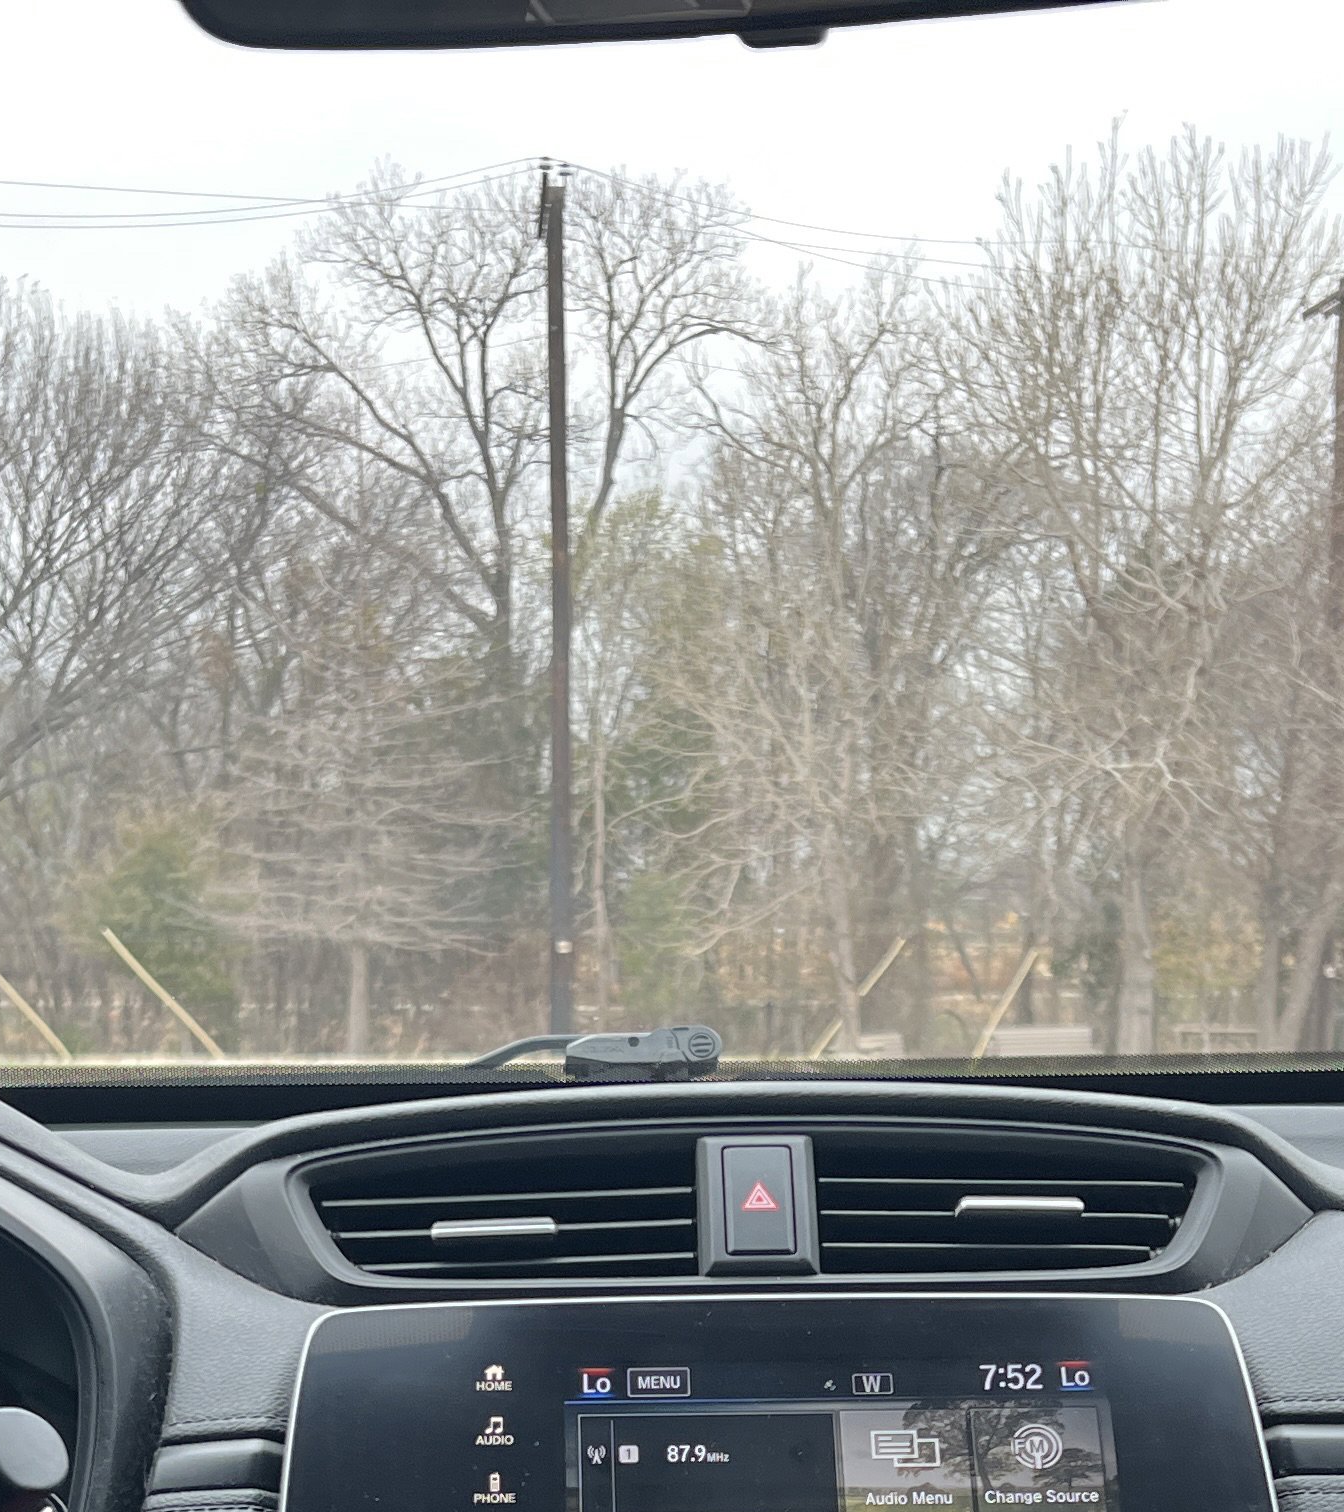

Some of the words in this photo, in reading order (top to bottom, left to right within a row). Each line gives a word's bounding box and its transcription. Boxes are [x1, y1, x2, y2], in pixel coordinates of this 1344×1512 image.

[582, 1373, 611, 1394] Lo
[637, 1375, 681, 1390] MENU
[862, 1375, 882, 1393] W
[979, 1363, 1044, 1391] 7:52
[1061, 1366, 1090, 1388] Lo
[475, 1380, 513, 1392] HOME
[475, 1434, 514, 1446] AUDIO
[473, 1492, 517, 1504] PHONE
[865, 1490, 908, 1506] Audio
[912, 1490, 954, 1505] Menu
[984, 1489, 1043, 1506] Change
[1046, 1487, 1100, 1503] Source
